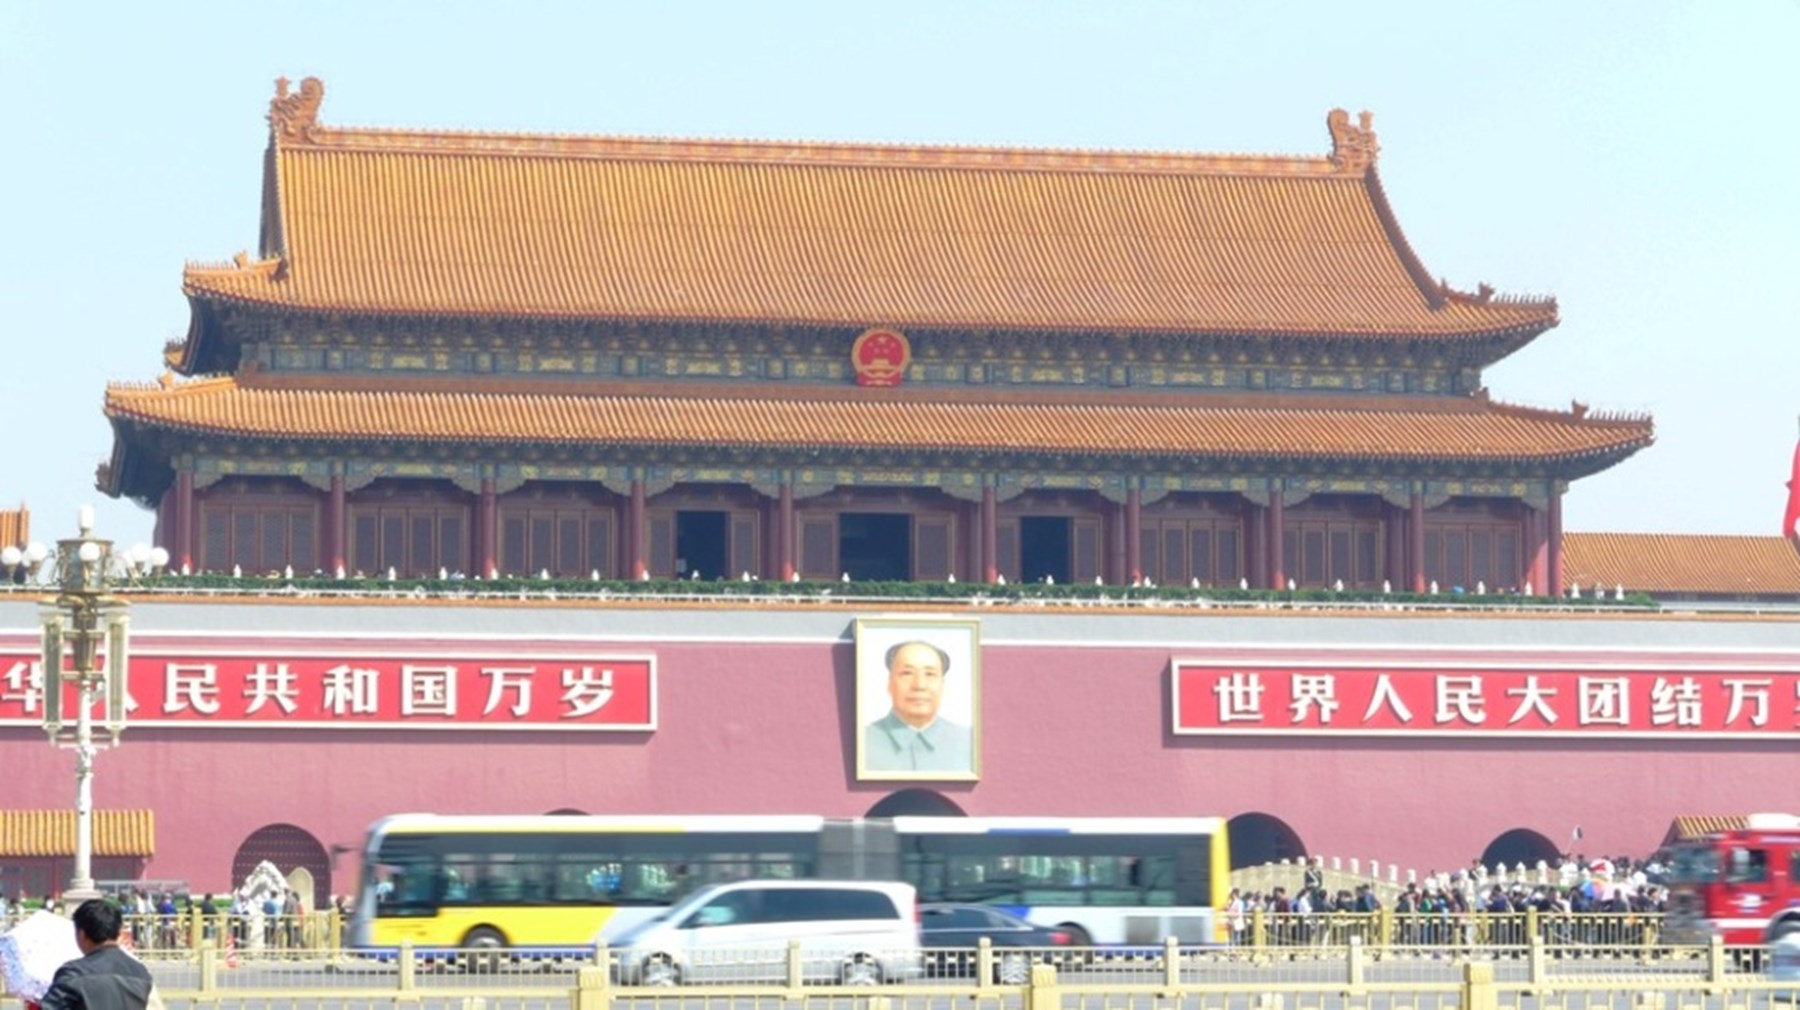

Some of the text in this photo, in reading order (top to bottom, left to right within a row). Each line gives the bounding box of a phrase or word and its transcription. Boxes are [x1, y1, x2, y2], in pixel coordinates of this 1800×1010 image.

[1213, 672, 1800, 727] 世界人民大团结万
